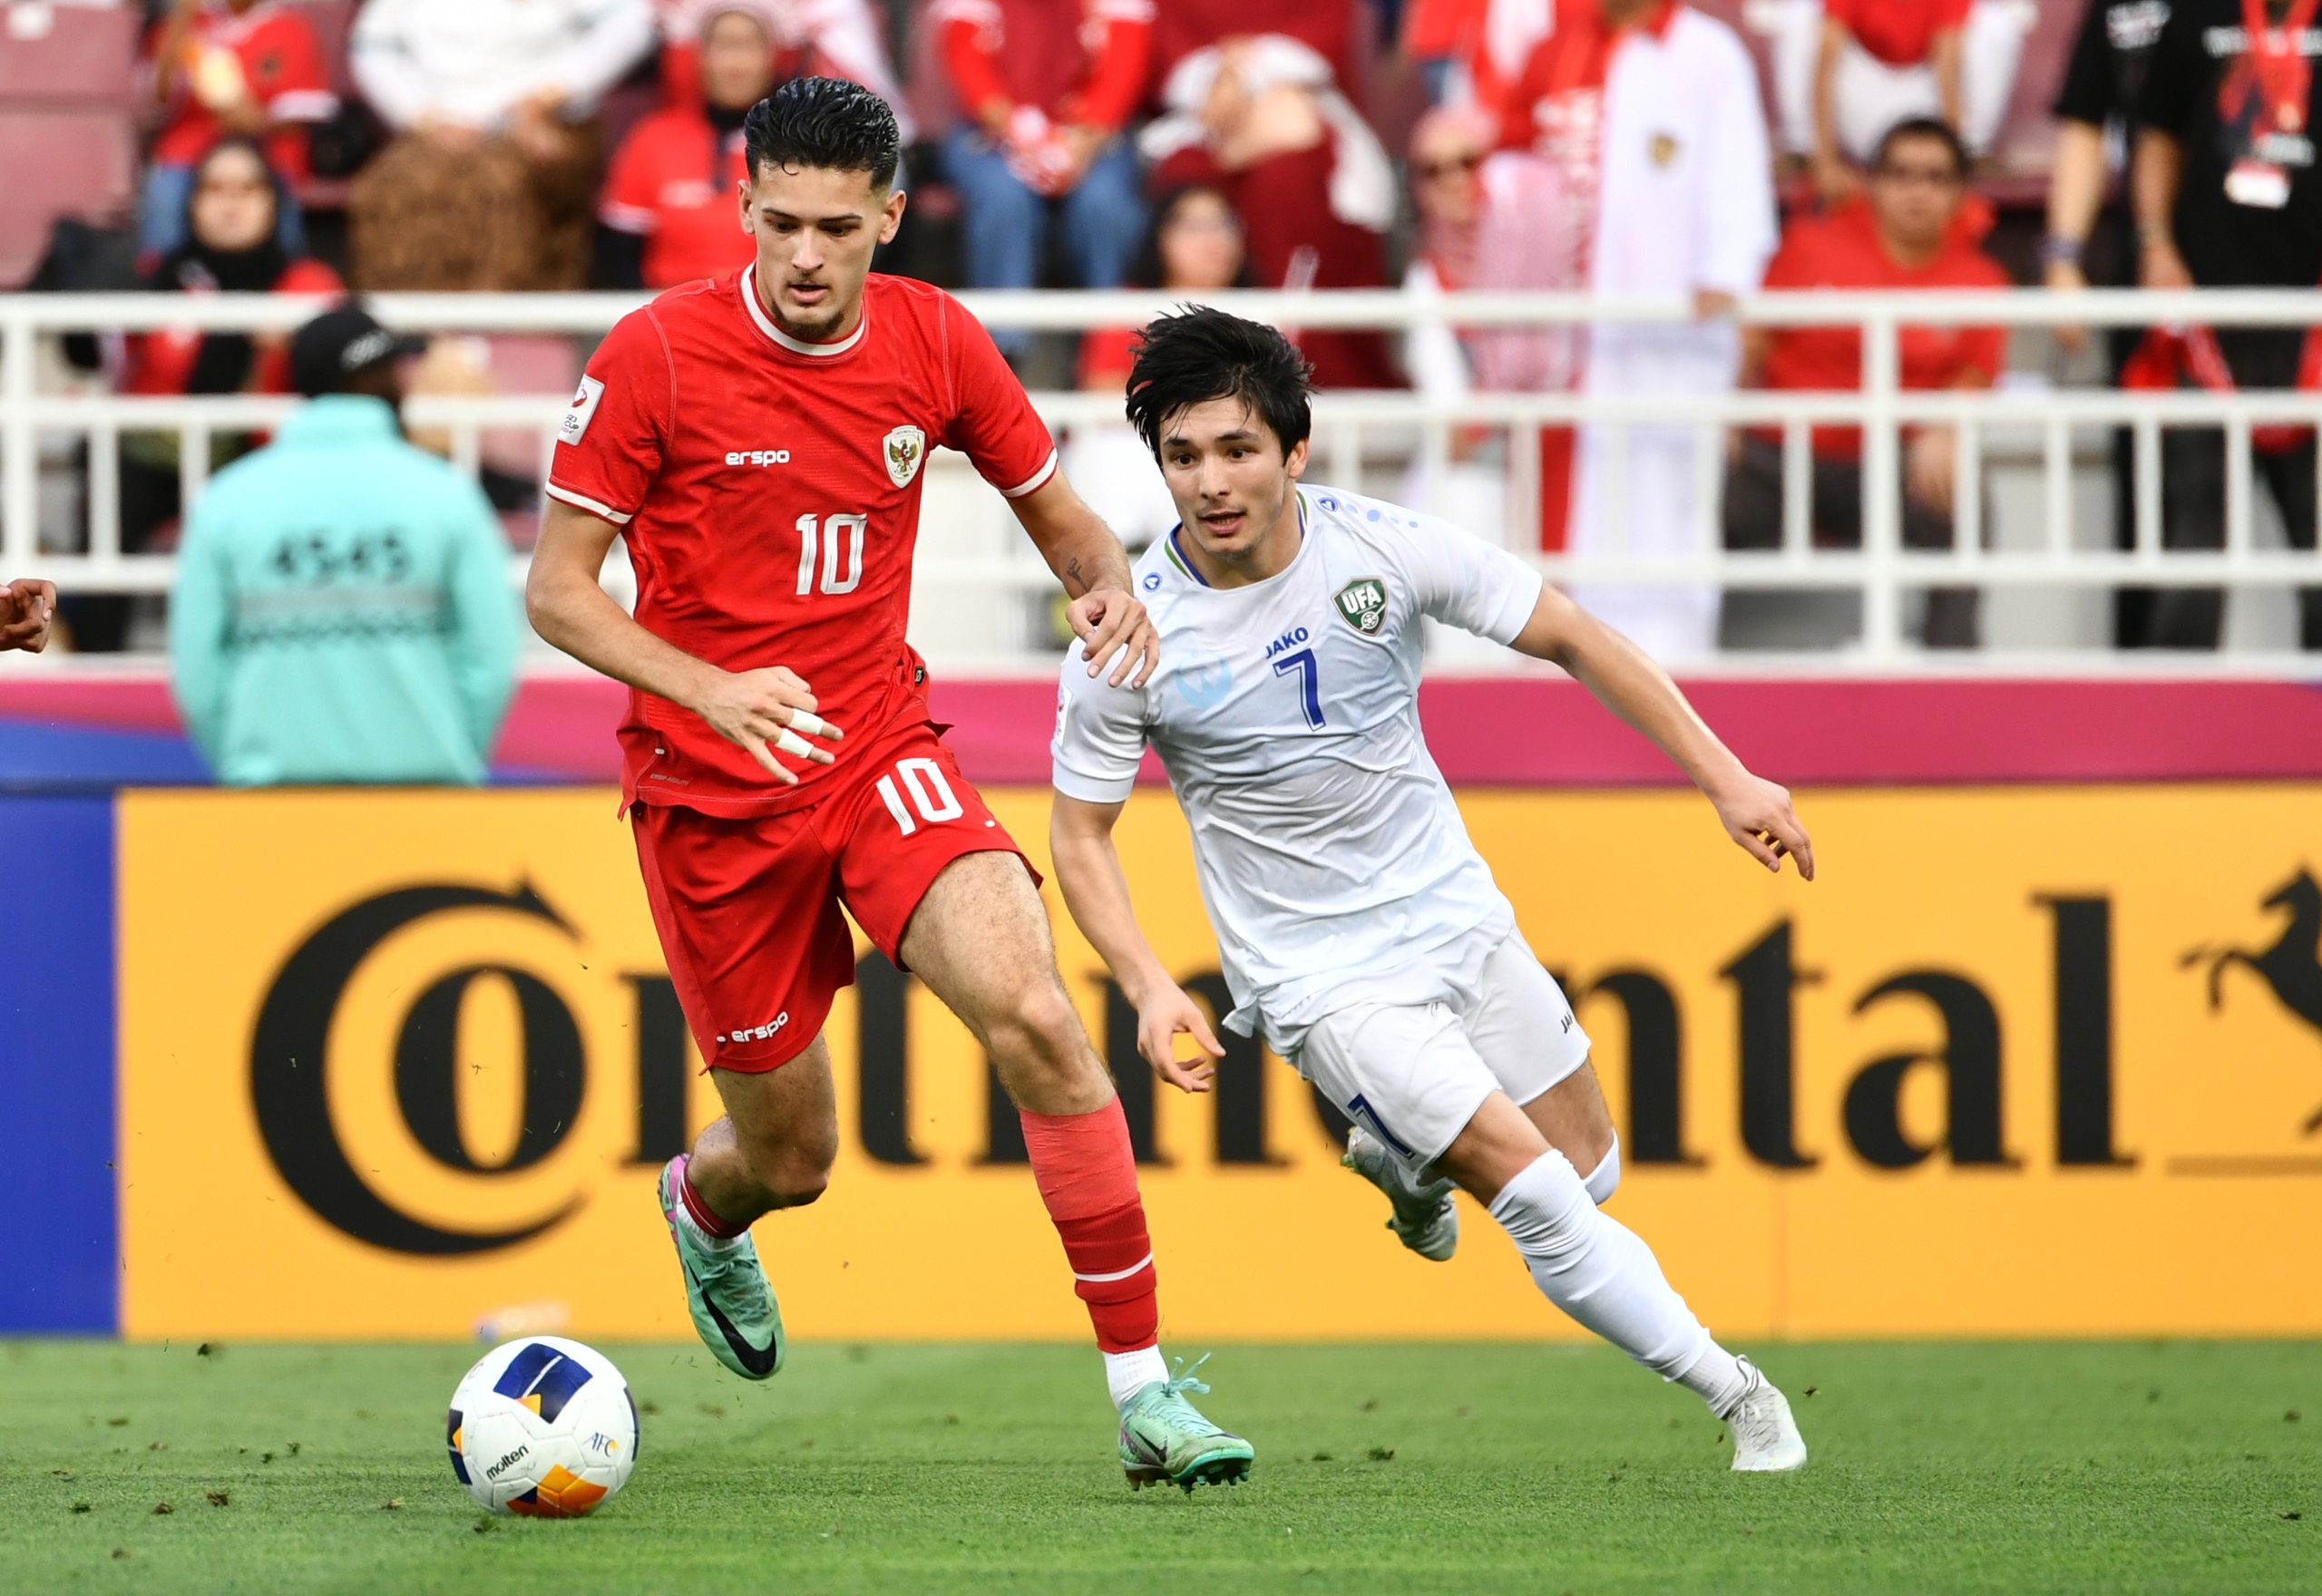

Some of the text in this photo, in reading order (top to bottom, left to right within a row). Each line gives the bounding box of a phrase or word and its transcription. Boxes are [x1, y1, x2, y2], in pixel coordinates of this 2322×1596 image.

[564, 420, 580, 430] CUP
[725, 449, 790, 468] erspo
[795, 512, 868, 596] 10
[1341, 582, 1382, 615] UFA
[1265, 627, 1309, 659] JAKO
[1272, 647, 1327, 733] 7
[875, 757, 964, 836] 10
[731, 1011, 789, 1043] erspo
[1347, 1093, 1415, 1161] 7
[485, 1443, 530, 1481] molten
